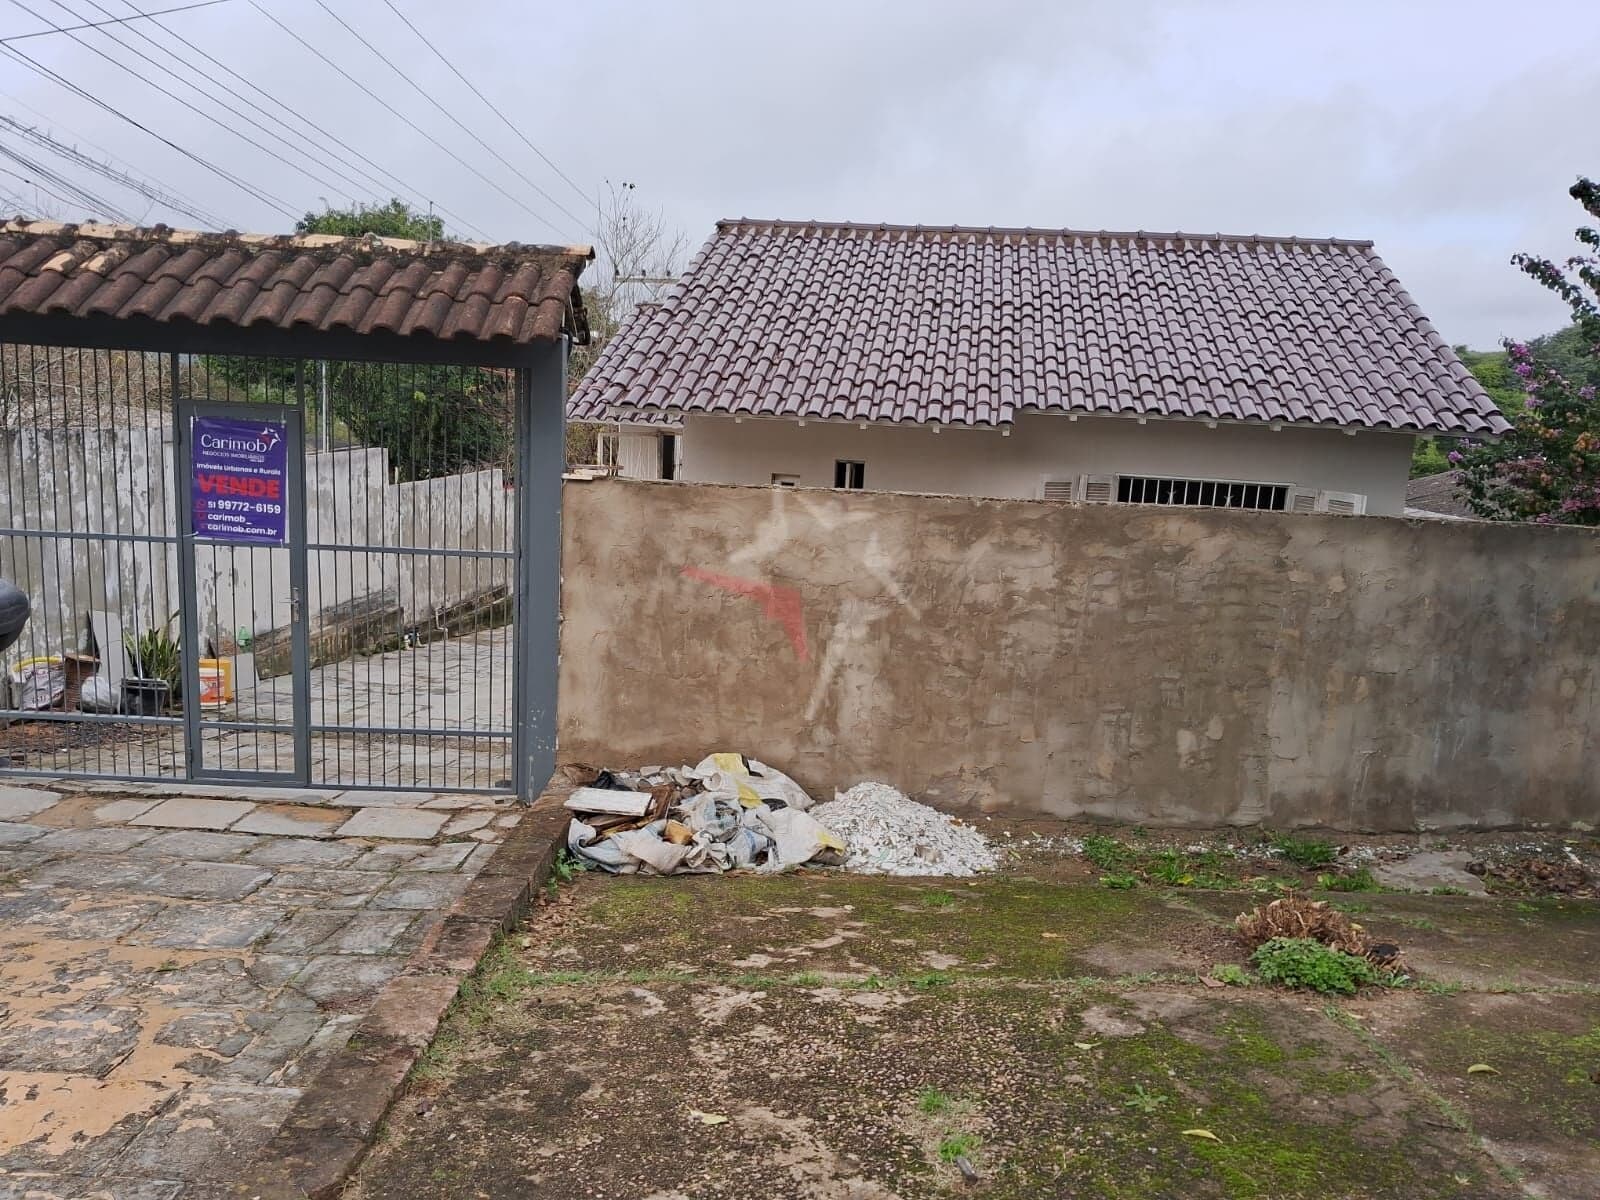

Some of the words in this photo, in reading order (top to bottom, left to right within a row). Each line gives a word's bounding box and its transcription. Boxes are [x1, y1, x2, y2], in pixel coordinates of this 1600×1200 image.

[201, 434, 267, 453] Carimob
[196, 463, 223, 471] Imóveis
[224, 464, 253, 473] Urbanos
[259, 467, 281, 475] Rurais
[198, 473, 280, 499] VENDE
[207, 501, 217, 509] 51
[218, 500, 281, 514] 99772-6159
[207, 523, 278, 535] carimob.com.br
